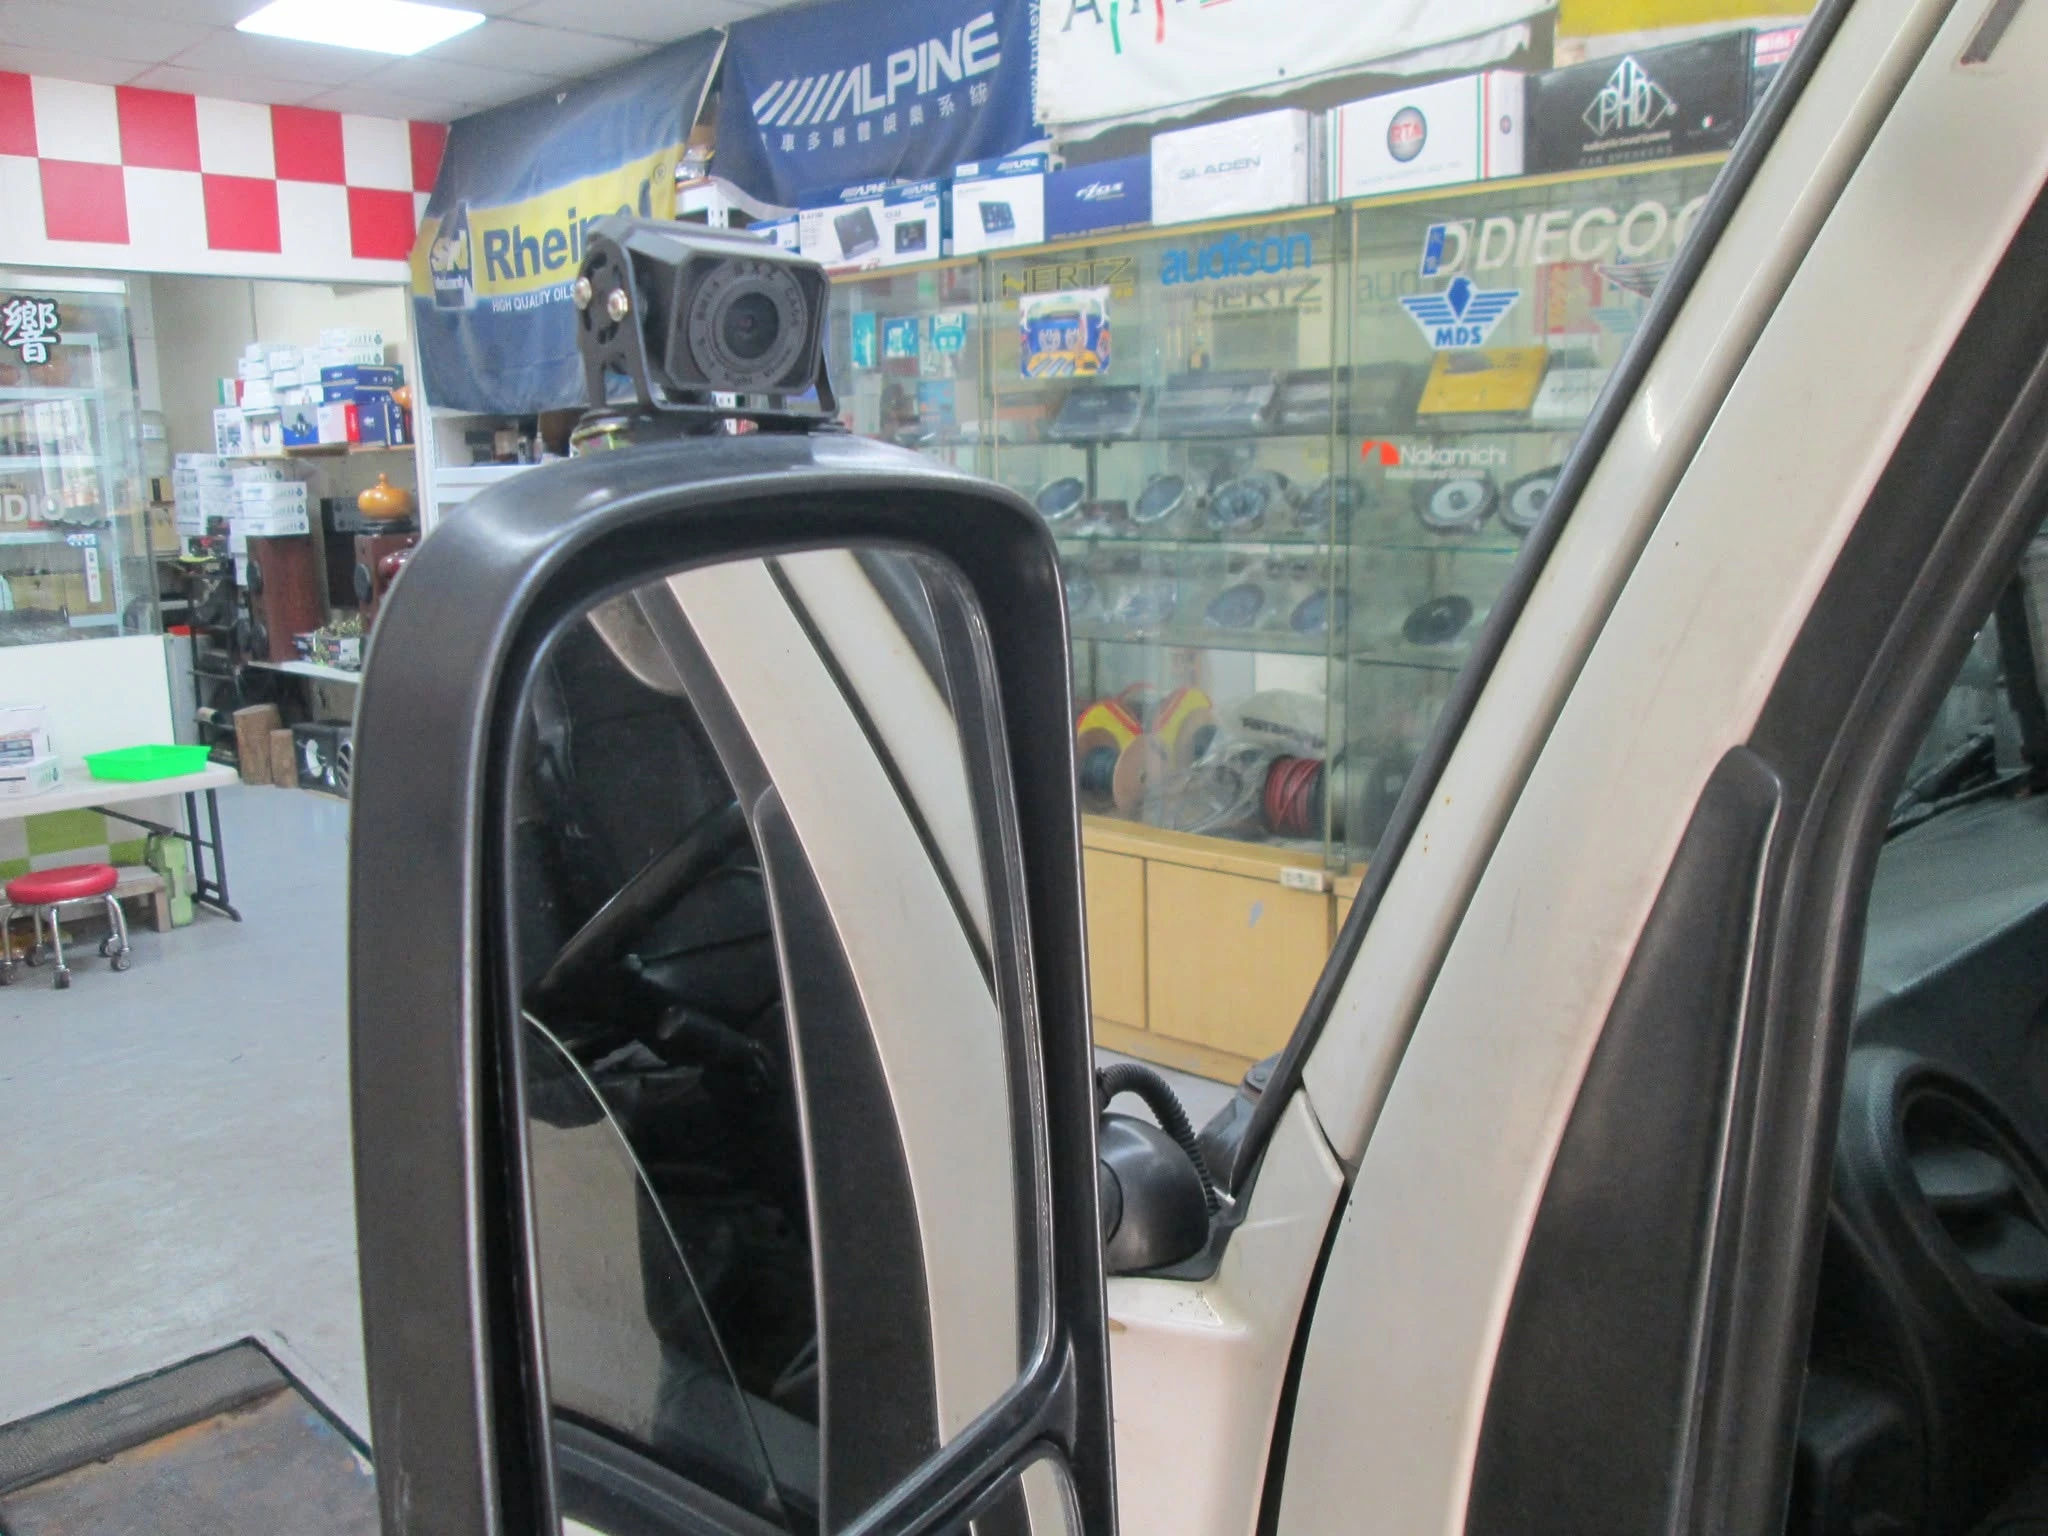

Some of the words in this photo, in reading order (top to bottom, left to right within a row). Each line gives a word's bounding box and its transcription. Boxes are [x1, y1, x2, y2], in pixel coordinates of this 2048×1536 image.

[827, 12, 1000, 122] ALPINE
[1161, 231, 1312, 287] audison
[1002, 256, 1135, 297] HERTZ
[492, 297, 512, 313] HIGH
[513, 289, 550, 311] QUALITY
[1435, 325, 1482, 347] MDS
[1400, 443, 1507, 465] Nakamichi
[0, 493, 65, 522] DIO
